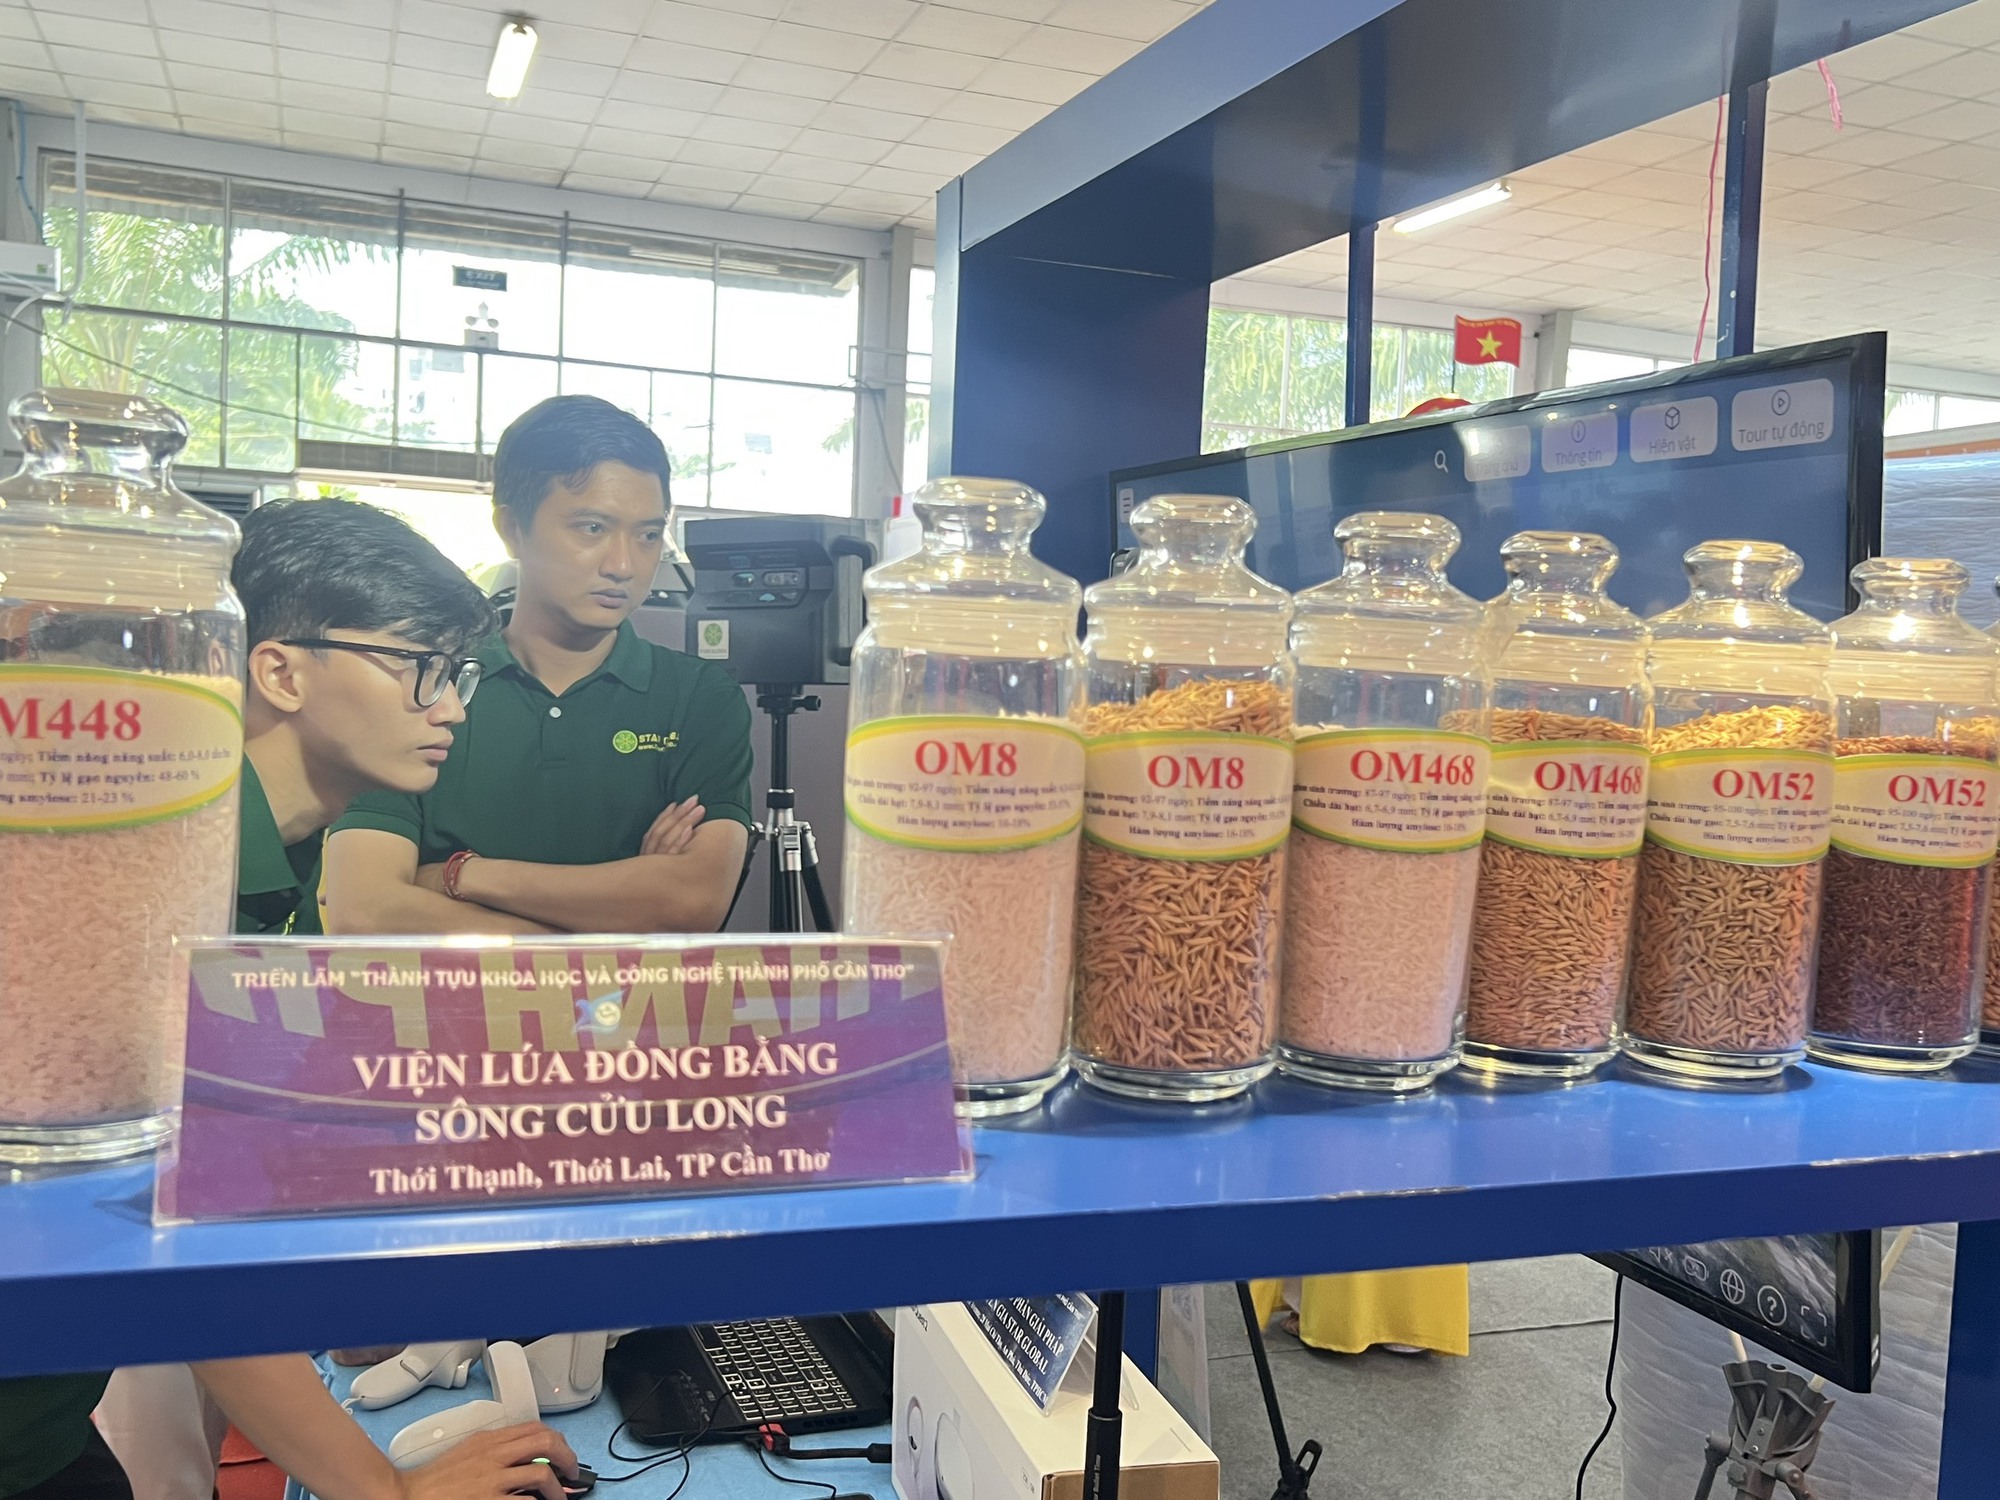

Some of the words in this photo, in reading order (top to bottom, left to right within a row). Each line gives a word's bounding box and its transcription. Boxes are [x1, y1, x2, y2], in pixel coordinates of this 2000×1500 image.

[1649, 438, 1675, 455] Hiện
[1678, 435, 1696, 453] vật
[1739, 426, 1768, 444] Tour
[1772, 424, 1787, 443] tự
[1790, 420, 1825, 440] động
[1556, 451, 1586, 467] Thông
[1588, 449, 1603, 462] tin
[914, 740, 1018, 777] OM8
[1147, 754, 1246, 790] OM8
[1350, 749, 1475, 785] OM468
[1534, 761, 1644, 795] OM468
[1712, 769, 1815, 801] OM52
[1888, 774, 1987, 807] OM52
[232, 966, 297, 989] TRIỂN
[303, 967, 345, 988] LÃM
[435, 969, 477, 992] TỰU
[481, 969, 537, 987] KHOA
[540, 969, 582, 989] HỌC
[585, 965, 612, 986] VÀ
[614, 963, 669, 983] CÔNG
[672, 962, 725, 987] NGHỆ
[728, 960, 789, 982] THÀNH
[792, 960, 831, 981] PHỐ
[833, 959, 868, 980] CẦN
[352, 1050, 469, 1098] VIỆN
[480, 1042, 574, 1087] LÚA
[584, 1040, 713, 1083] ĐỒNG
[723, 1035, 839, 1078] BẰNG
[415, 1096, 546, 1143] SÔNG
[556, 1092, 653, 1137] CỬU
[665, 1094, 788, 1133] LONG
[369, 1166, 438, 1195] Thới
[444, 1162, 544, 1196] Thạnh,
[548, 1156, 614, 1186] Thới
[619, 1155, 672, 1182] Lai,
[675, 1153, 716, 1179] TP
[721, 1142, 773, 1177] Cần
[777, 1148, 832, 1173] Thơ
[996, 1303, 1009, 1325] GIA
[1005, 1316, 1025, 1344] STAR
[1020, 1335, 1049, 1375] GLOBAL
[1028, 1315, 1047, 1338] GIẢI
[1042, 1328, 1065, 1357] PHÁP
